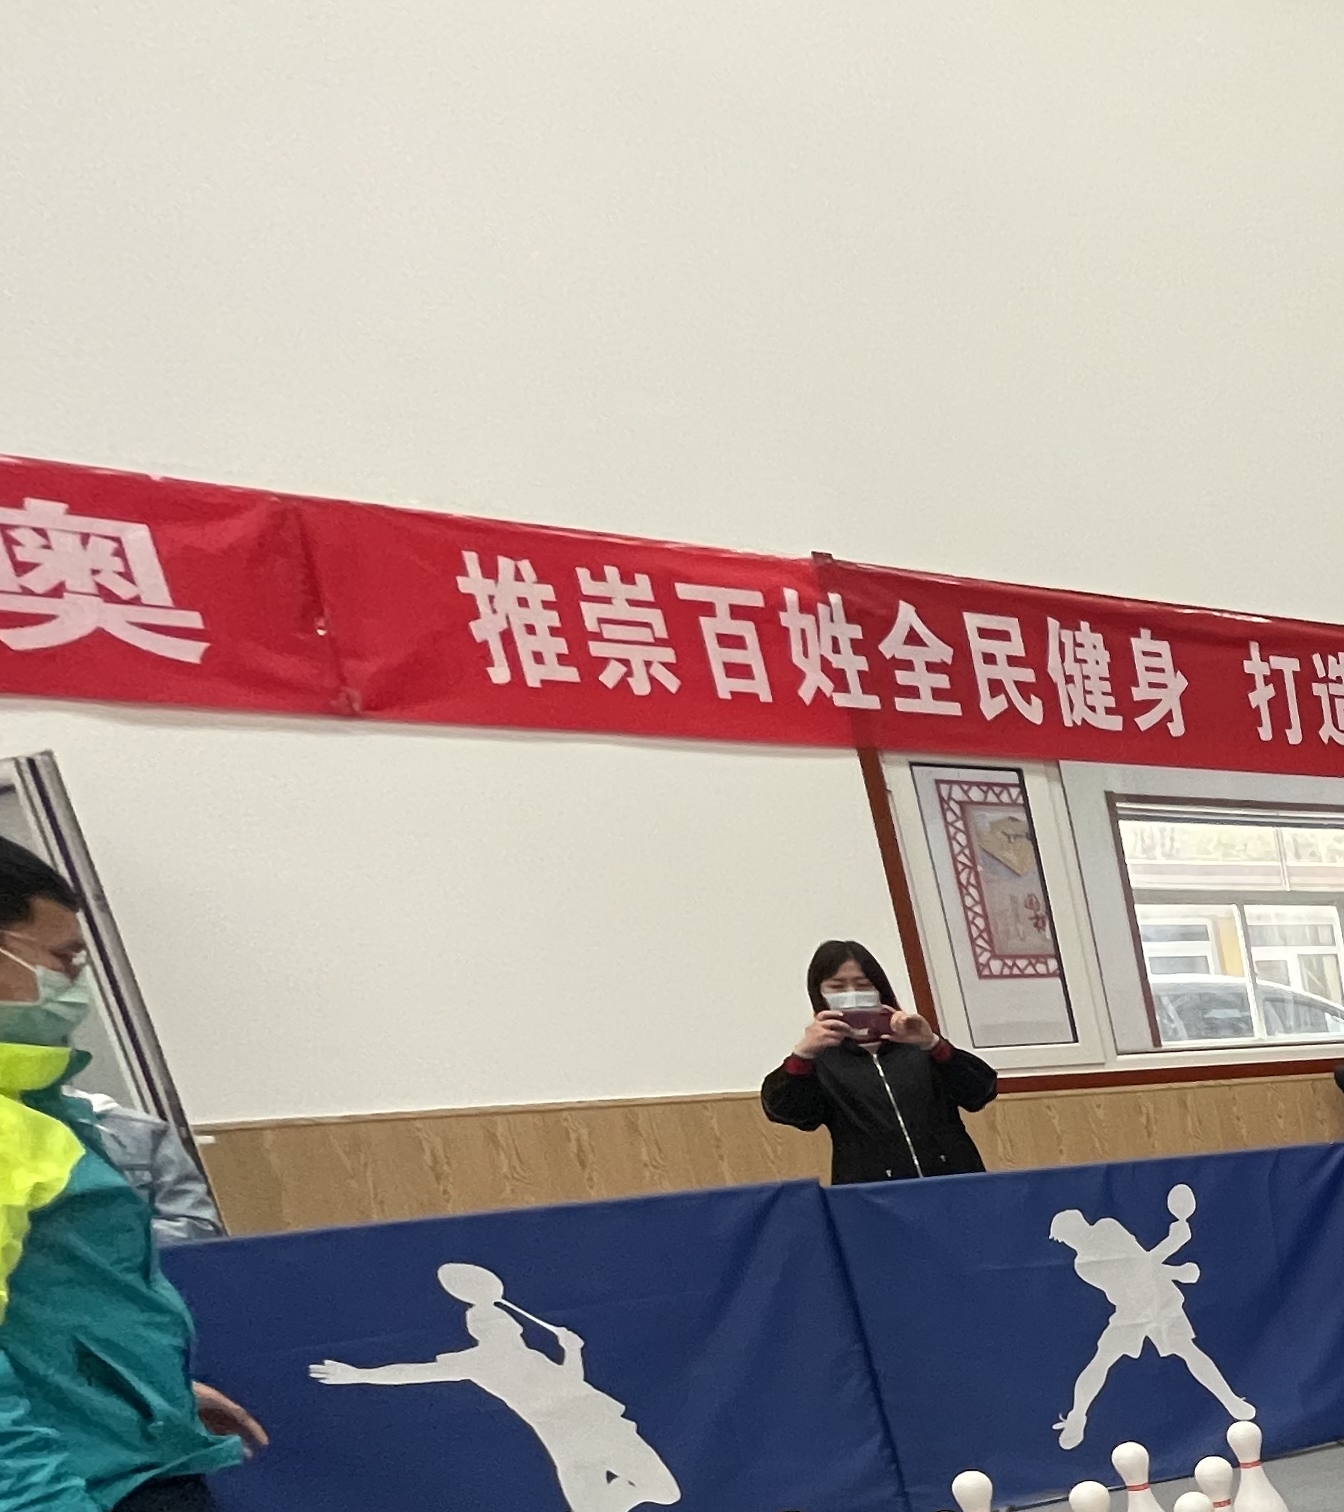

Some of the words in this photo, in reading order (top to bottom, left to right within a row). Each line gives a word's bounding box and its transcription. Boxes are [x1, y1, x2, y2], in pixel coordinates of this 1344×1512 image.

[0, 497, 210, 664] 奥
[456, 550, 1188, 739] 推崇百姓全民健身
